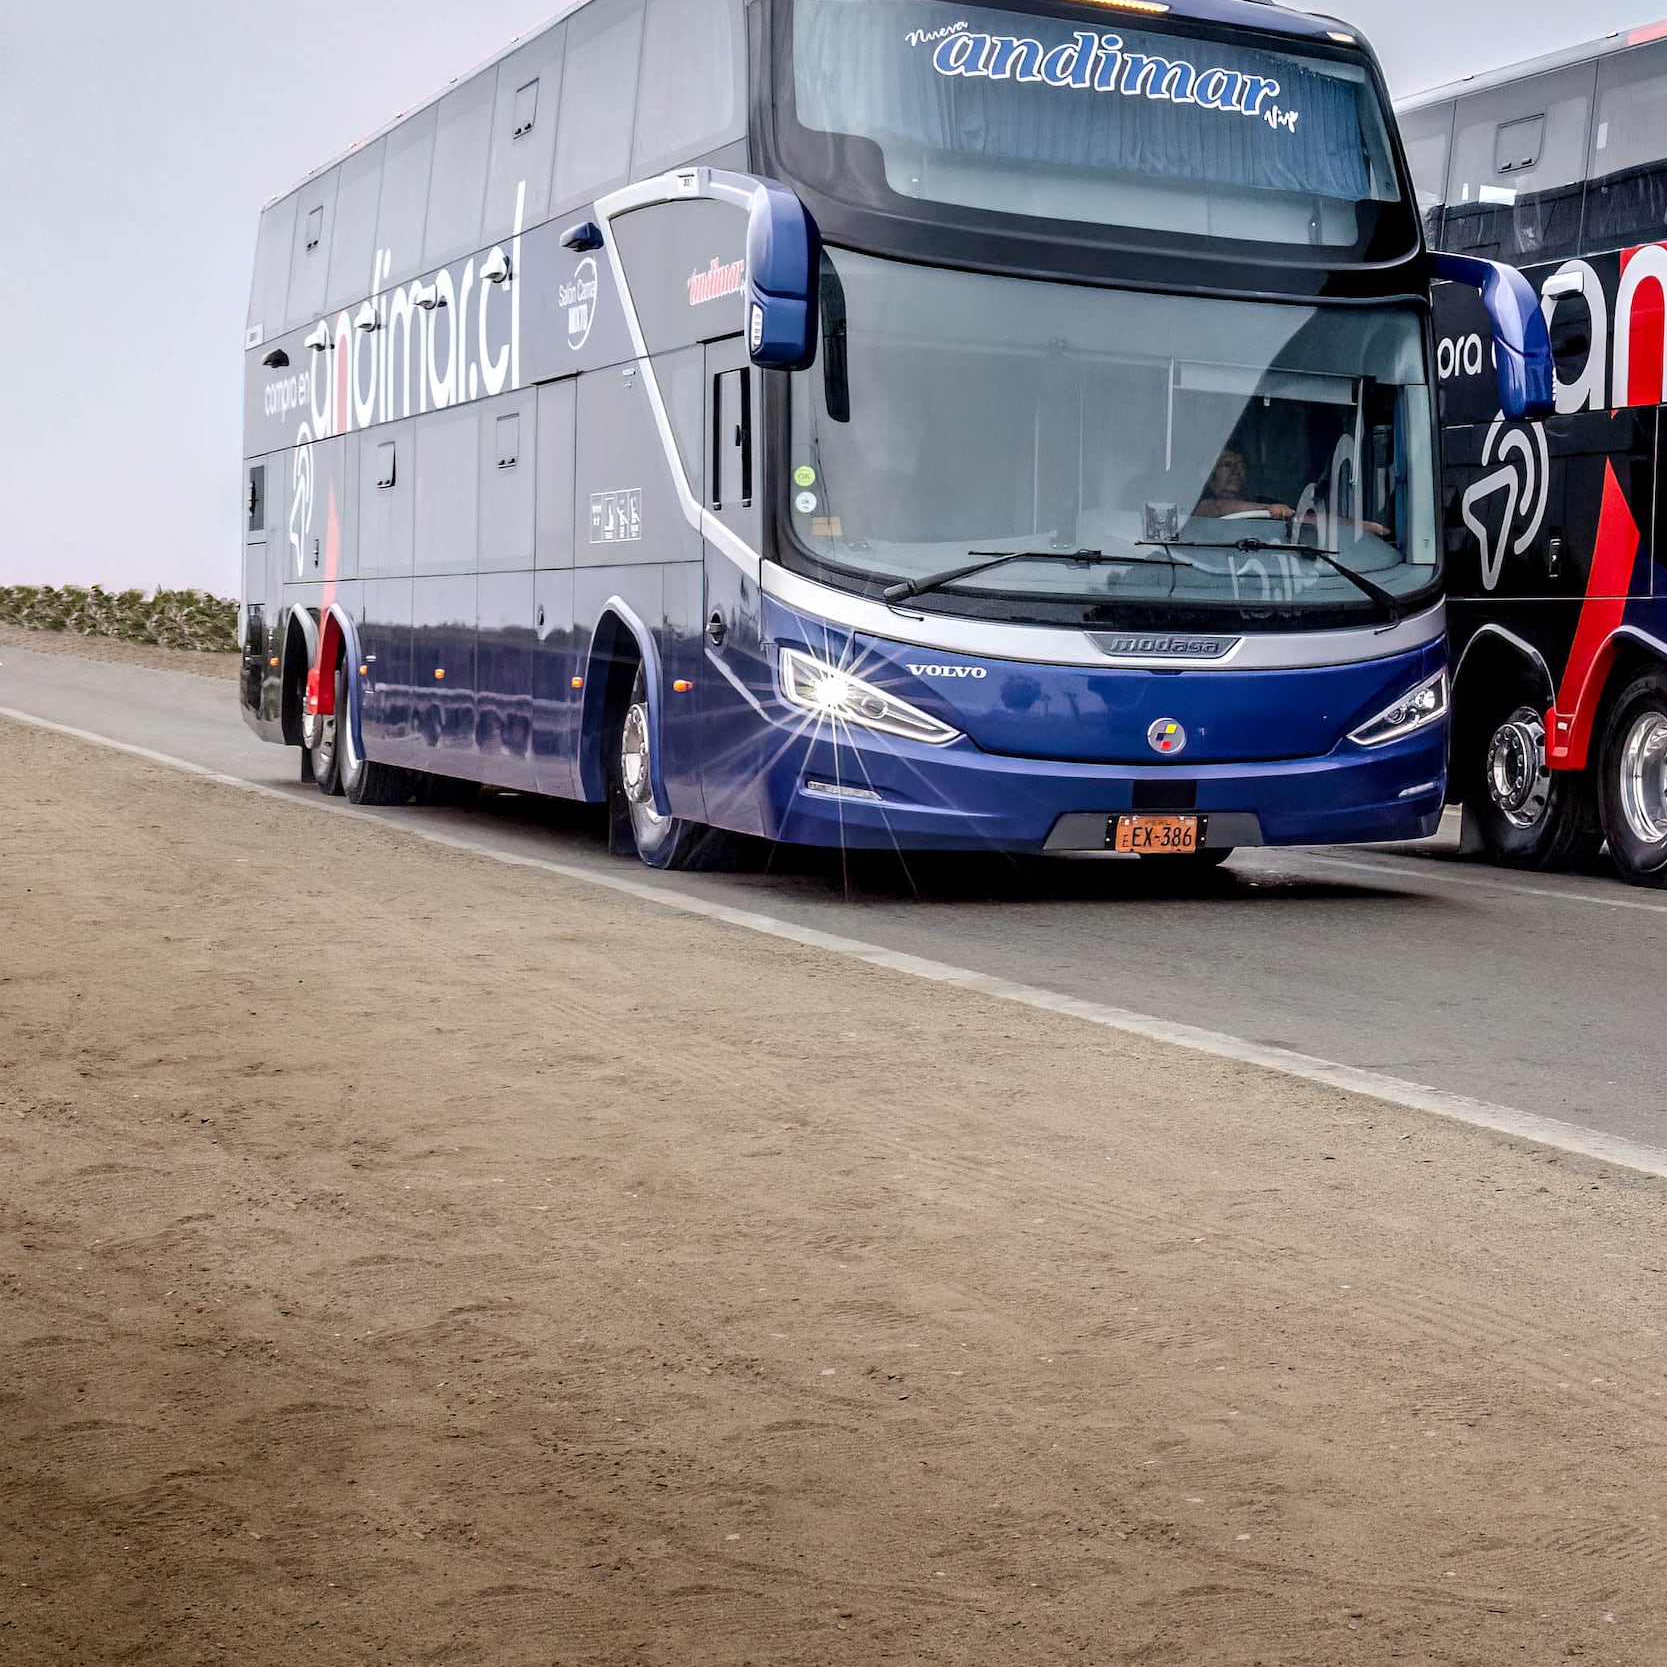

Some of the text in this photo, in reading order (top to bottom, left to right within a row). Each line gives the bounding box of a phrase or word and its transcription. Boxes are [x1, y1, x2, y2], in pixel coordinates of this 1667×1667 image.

[933, 31, 1280, 116] andimar
[309, 180, 526, 439] andimar.cl
[905, 664, 987, 679] VOLVO
[1131, 826, 1192, 847] EX-386
